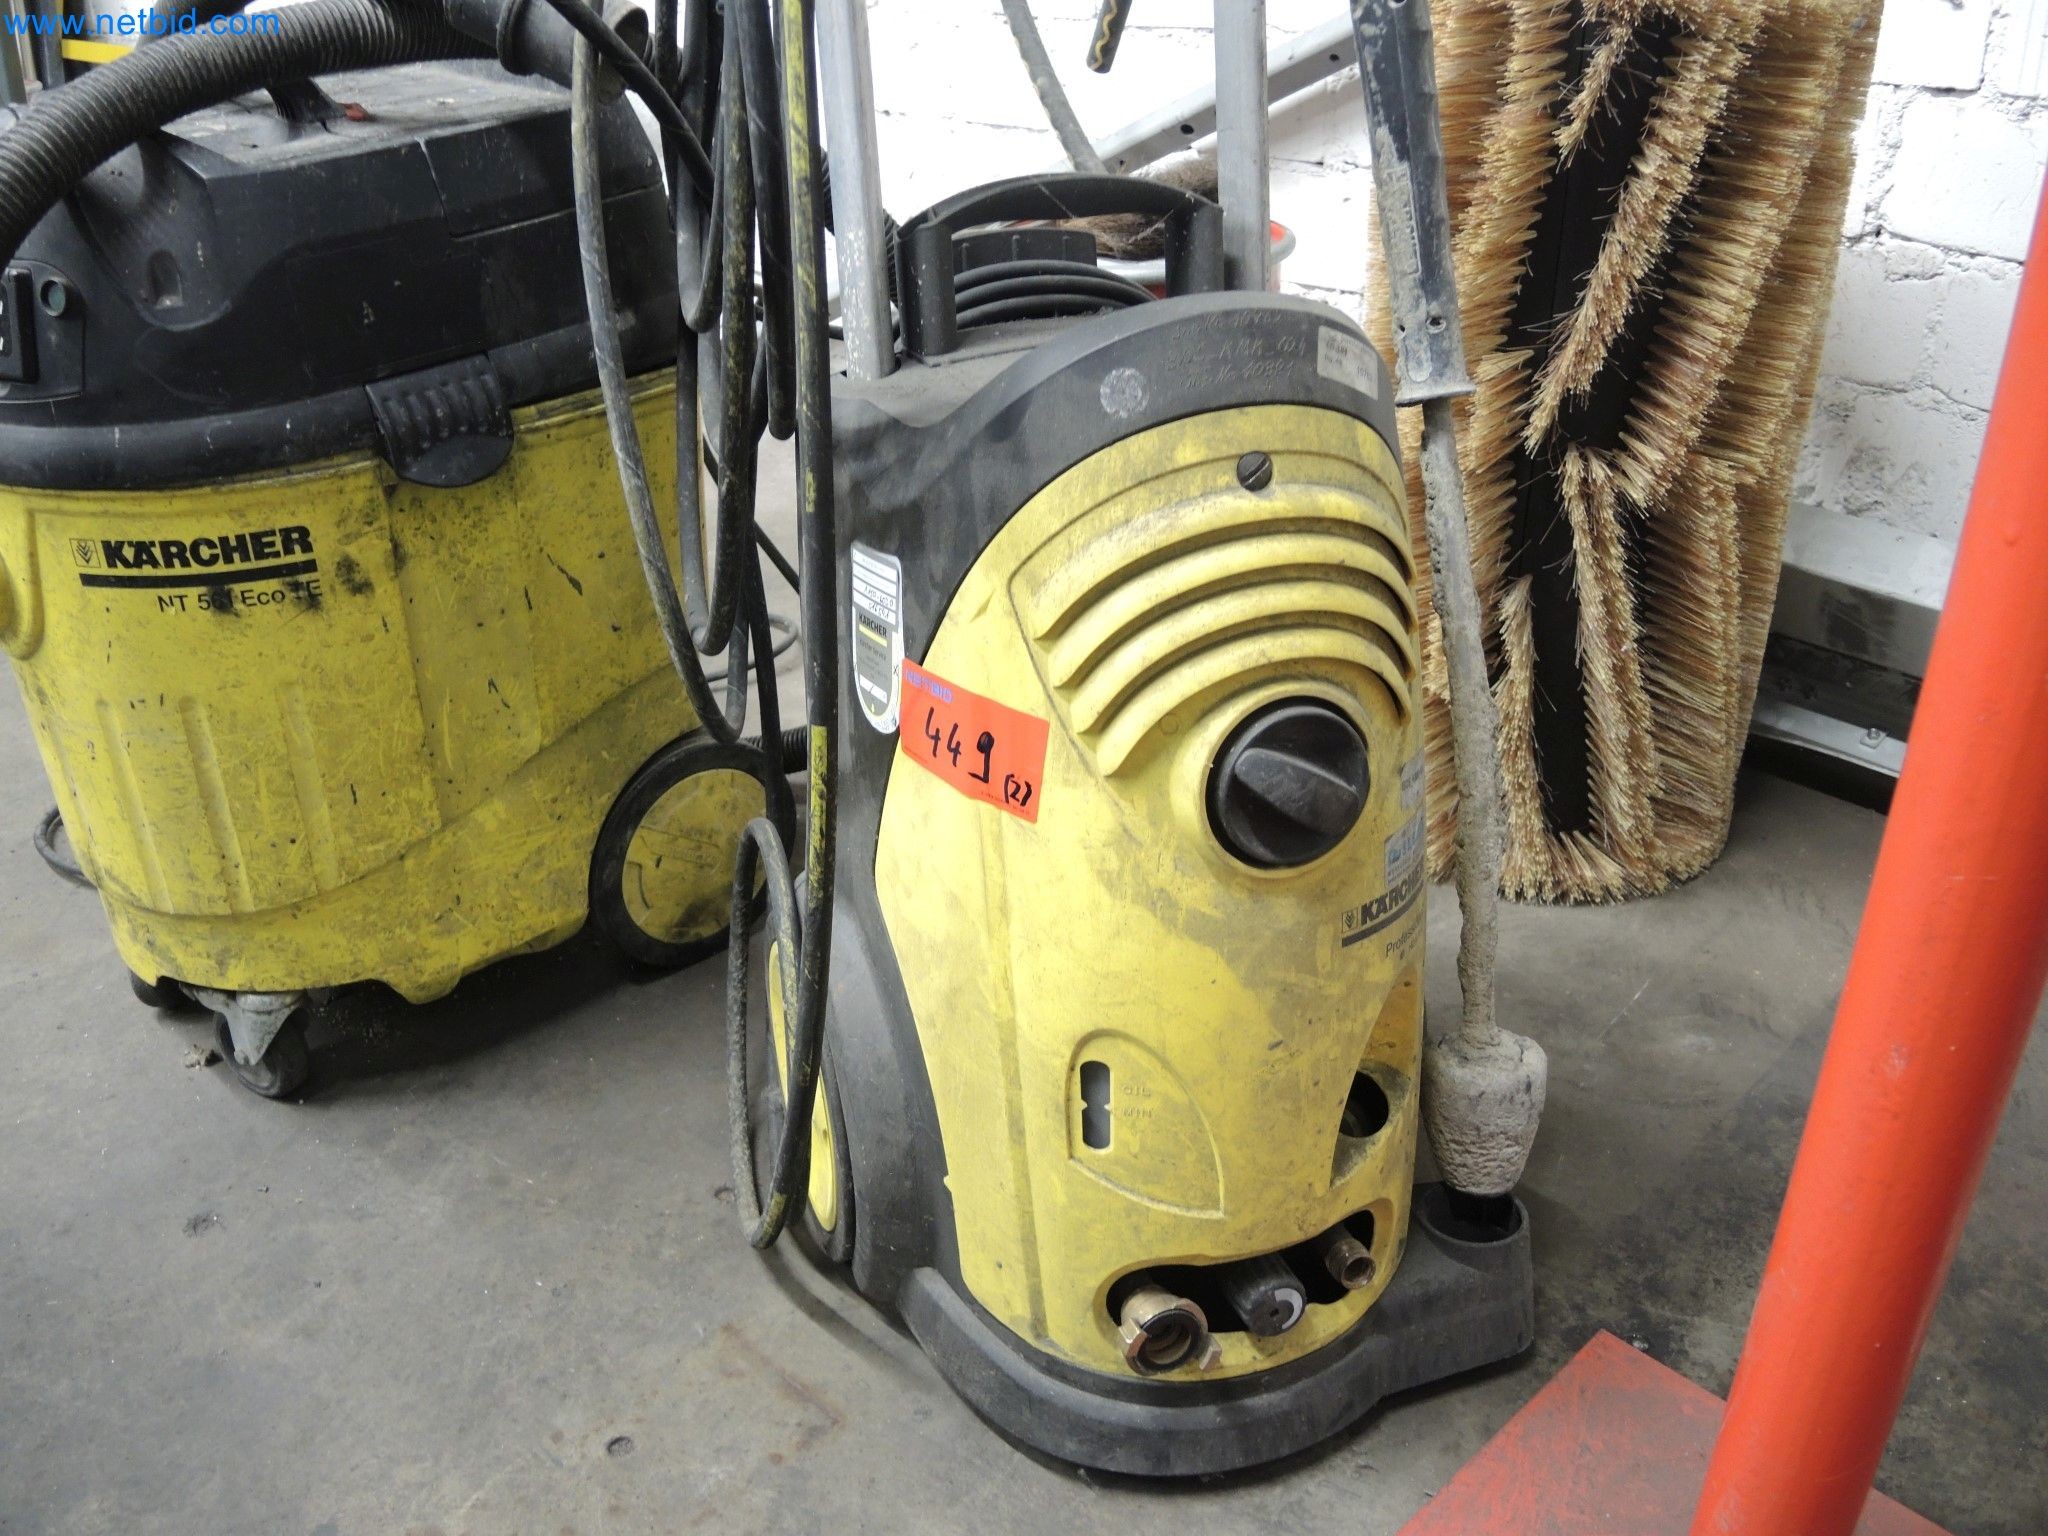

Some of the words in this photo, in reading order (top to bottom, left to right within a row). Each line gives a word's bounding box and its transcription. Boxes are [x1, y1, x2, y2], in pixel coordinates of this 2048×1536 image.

[101, 525, 314, 569] KÄRCHER
[157, 594, 188, 613] NT
[240, 588, 286, 608] Eco
[925, 706, 995, 784] 449
[1003, 773, 1033, 807] (2)
